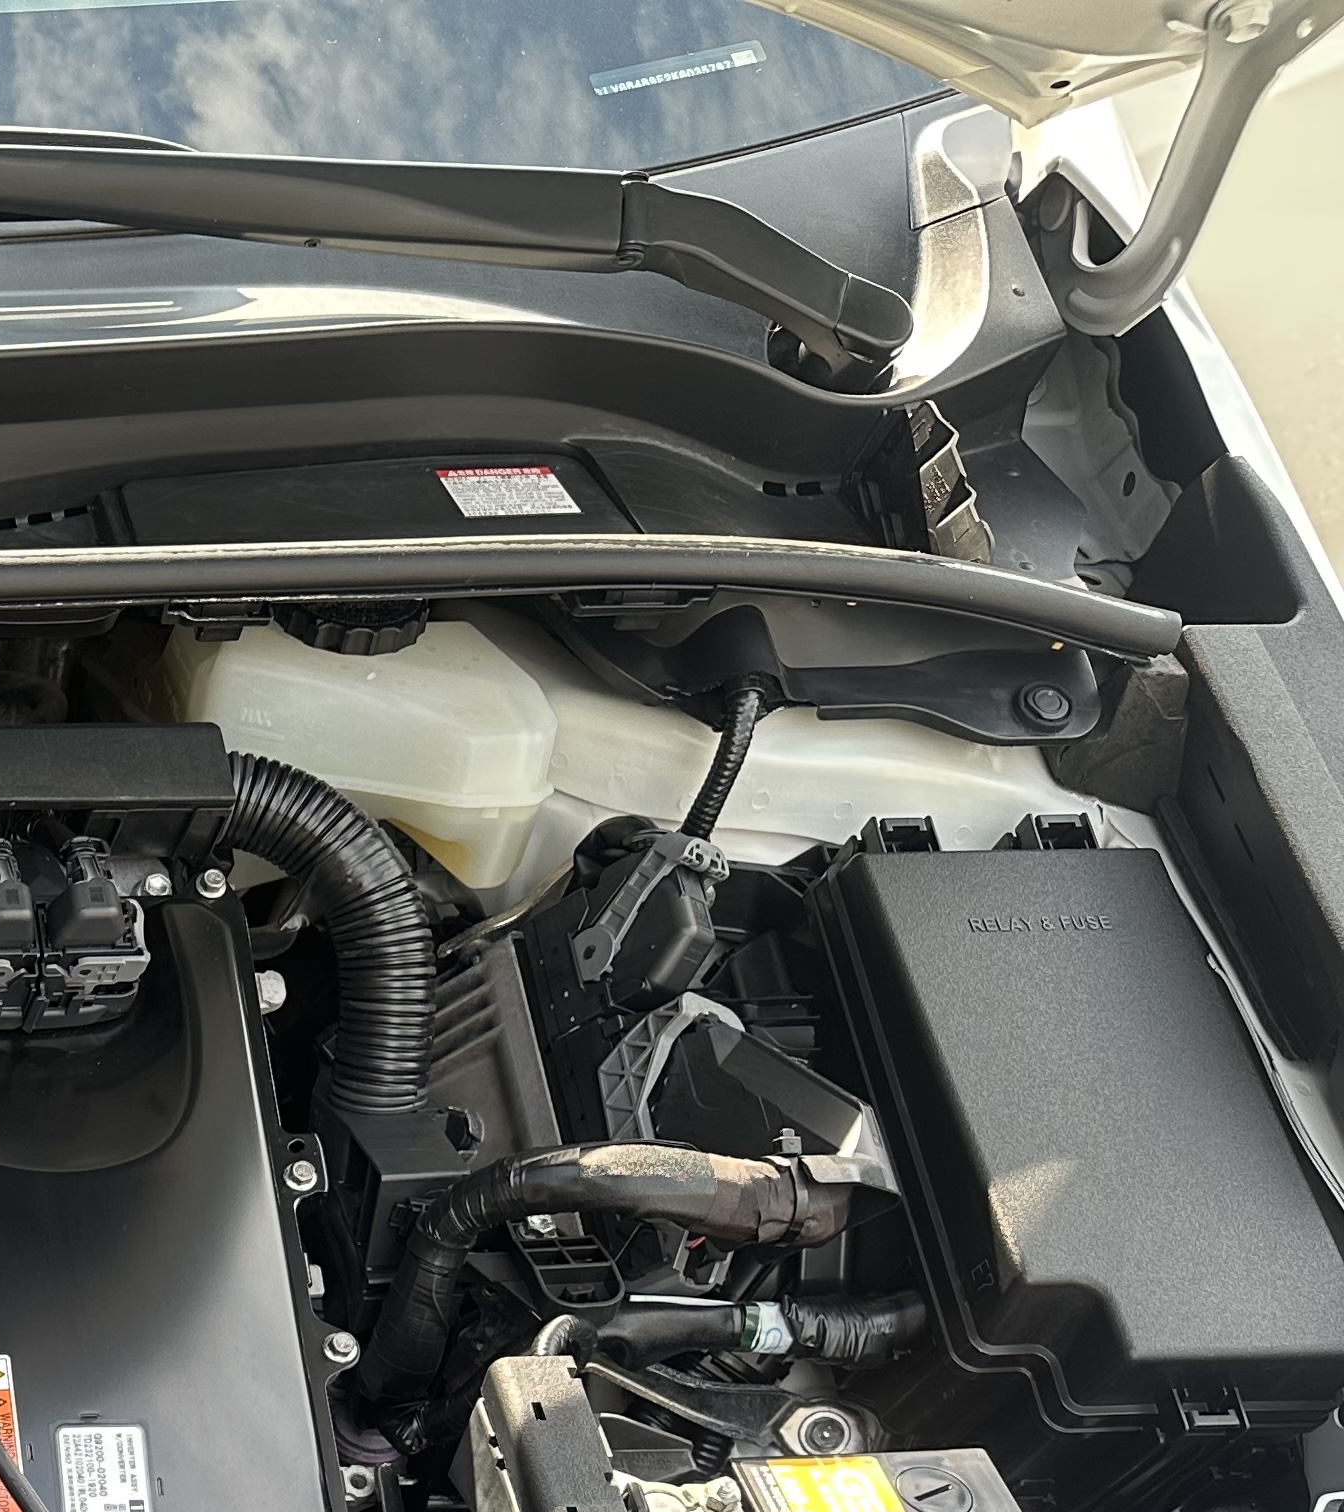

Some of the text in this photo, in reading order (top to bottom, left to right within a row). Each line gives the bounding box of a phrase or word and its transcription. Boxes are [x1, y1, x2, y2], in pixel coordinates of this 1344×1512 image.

[968, 914, 1113, 932] RELAY & FUSE
[62, 1433, 71, 1464] DENSO
[93, 1432, 107, 1497] G9200-02040
